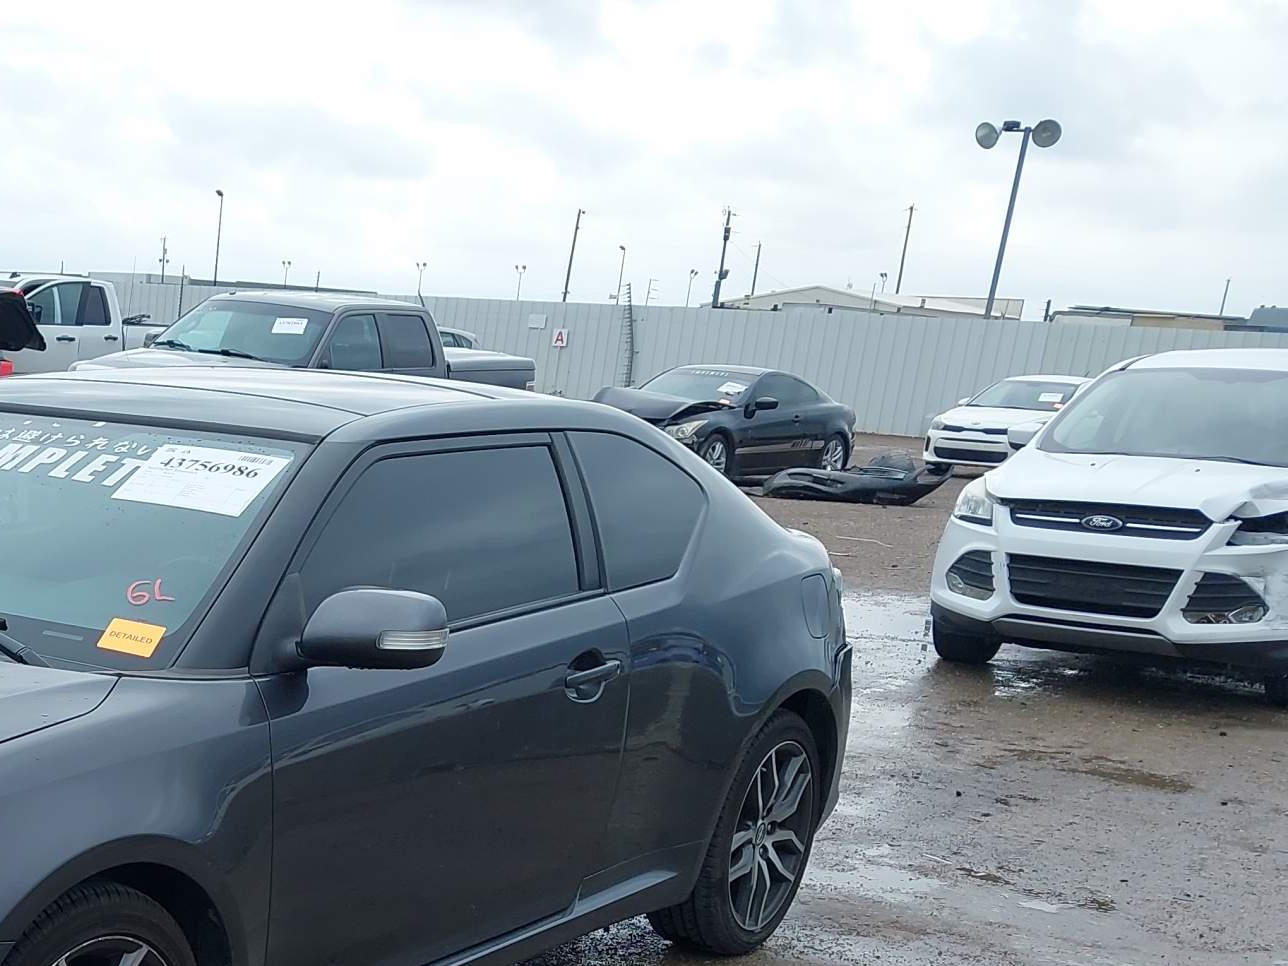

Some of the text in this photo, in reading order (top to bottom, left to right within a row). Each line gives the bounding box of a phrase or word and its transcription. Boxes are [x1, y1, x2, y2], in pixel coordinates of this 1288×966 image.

[554, 330, 565, 345] A
[160, 457, 260, 479] 43756986
[108, 630, 154, 645] DETAILED
